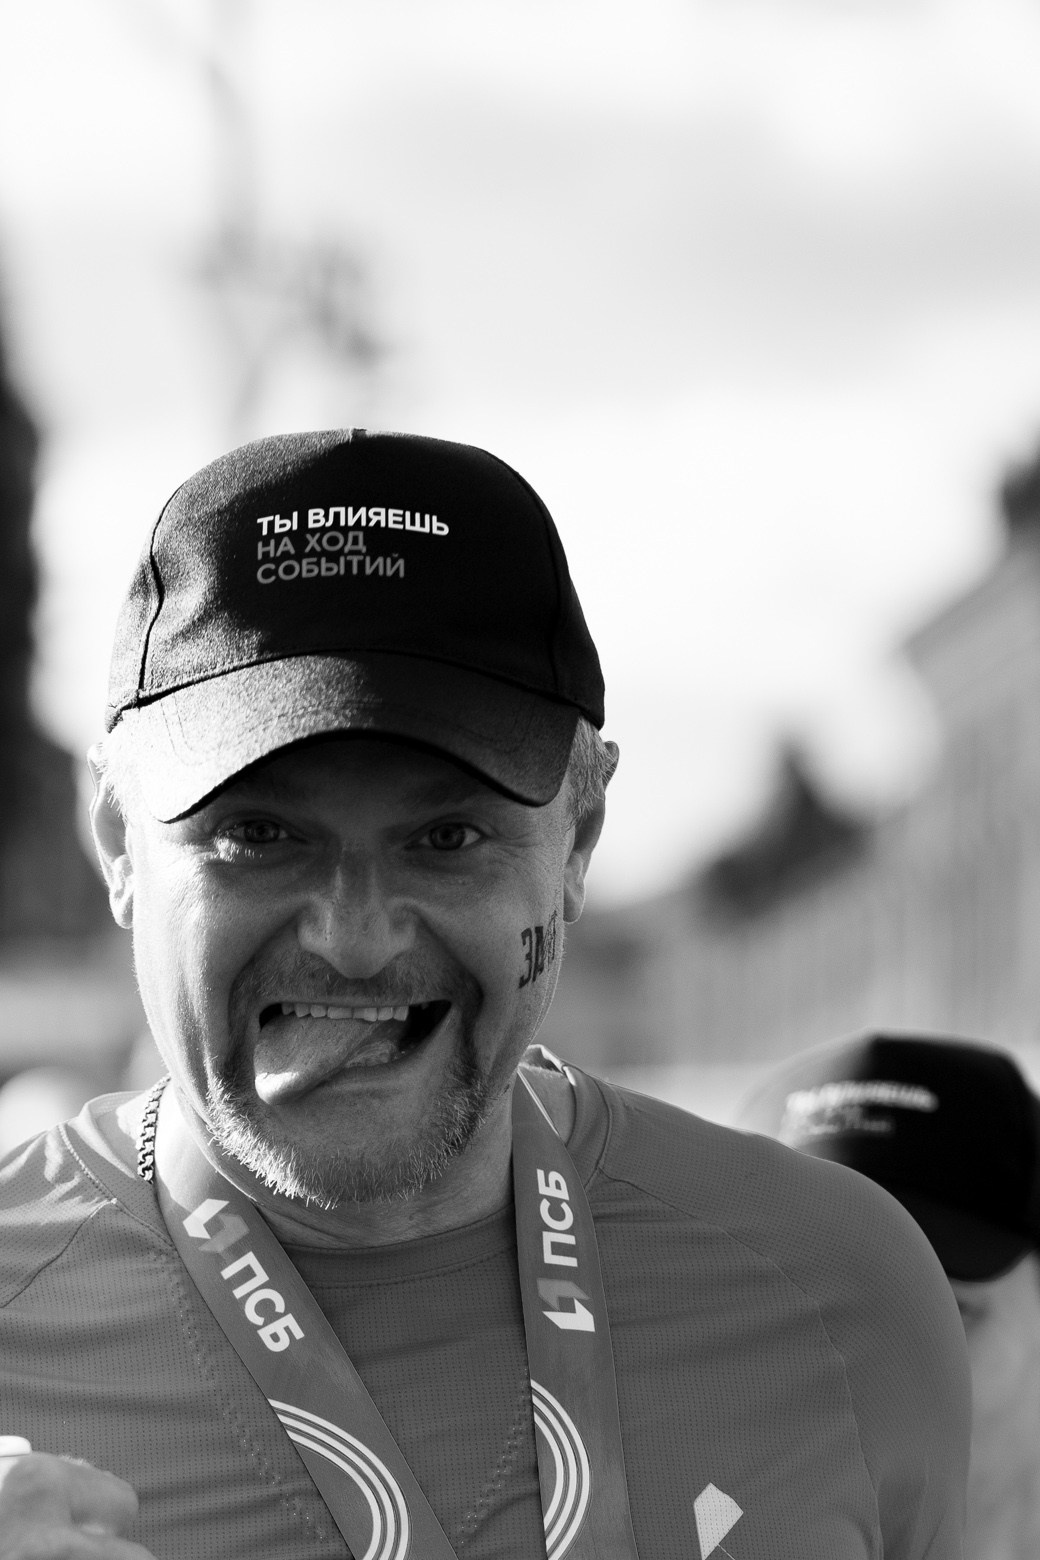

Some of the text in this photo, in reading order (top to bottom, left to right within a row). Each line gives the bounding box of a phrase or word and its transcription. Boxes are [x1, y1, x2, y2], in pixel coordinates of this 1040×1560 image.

[256, 506, 450, 536] ТЫ ВЛИЯЕШЬ
[257, 531, 367, 560] НА ХОД
[256, 553, 405, 584] СОБЫТИЙ
[536, 1168, 579, 1267] ПСБ
[220, 1251, 305, 1353] ПСБ
